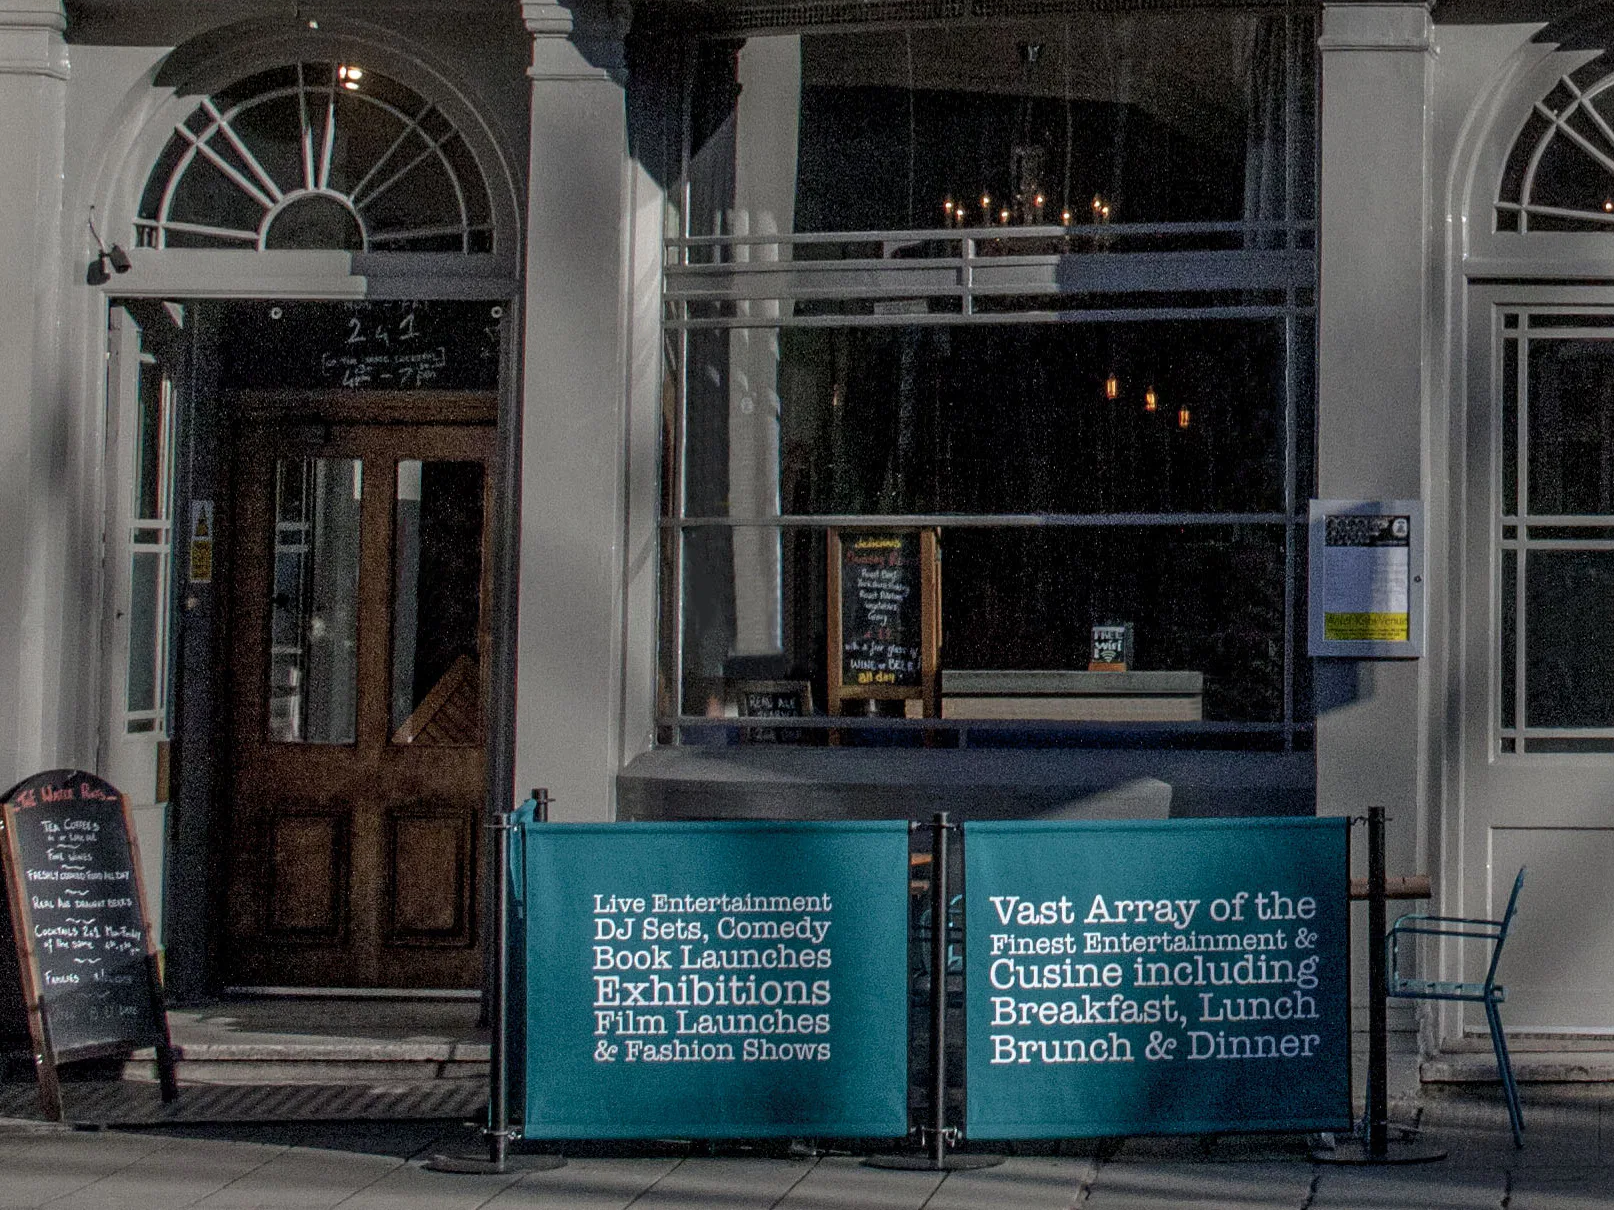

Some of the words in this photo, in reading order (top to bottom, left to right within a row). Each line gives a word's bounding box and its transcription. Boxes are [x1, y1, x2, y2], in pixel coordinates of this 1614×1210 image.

[593, 894, 645, 914] Live
[651, 893, 832, 913] Entertainment
[989, 896, 1075, 925] Vast
[1084, 894, 1201, 930] Array
[1209, 891, 1249, 921] of
[1254, 891, 1317, 920] the
[594, 917, 636, 940] DJ
[642, 917, 709, 943] Sets,
[717, 916, 832, 943] Comedy
[990, 932, 1077, 955] Finest
[1083, 929, 1288, 954] Entertainment
[1295, 927, 1318, 949] &
[593, 945, 672, 970] Book
[680, 944, 832, 969] Launches
[989, 957, 1123, 989] Cusine
[1133, 954, 1320, 990] including
[593, 975, 832, 1007] Exhibitions
[593, 1010, 668, 1035] Film
[676, 1009, 831, 1034] Launches
[990, 993, 1188, 1028] Breakfast,
[1199, 990, 1320, 1022] Lunch
[594, 1040, 618, 1062] &
[625, 1040, 735, 1062] Fashion
[743, 1038, 832, 1061] Shows
[990, 1032, 1135, 1065] Brunch
[1144, 1031, 1178, 1061] &
[1187, 1031, 1321, 1060] Dinner
